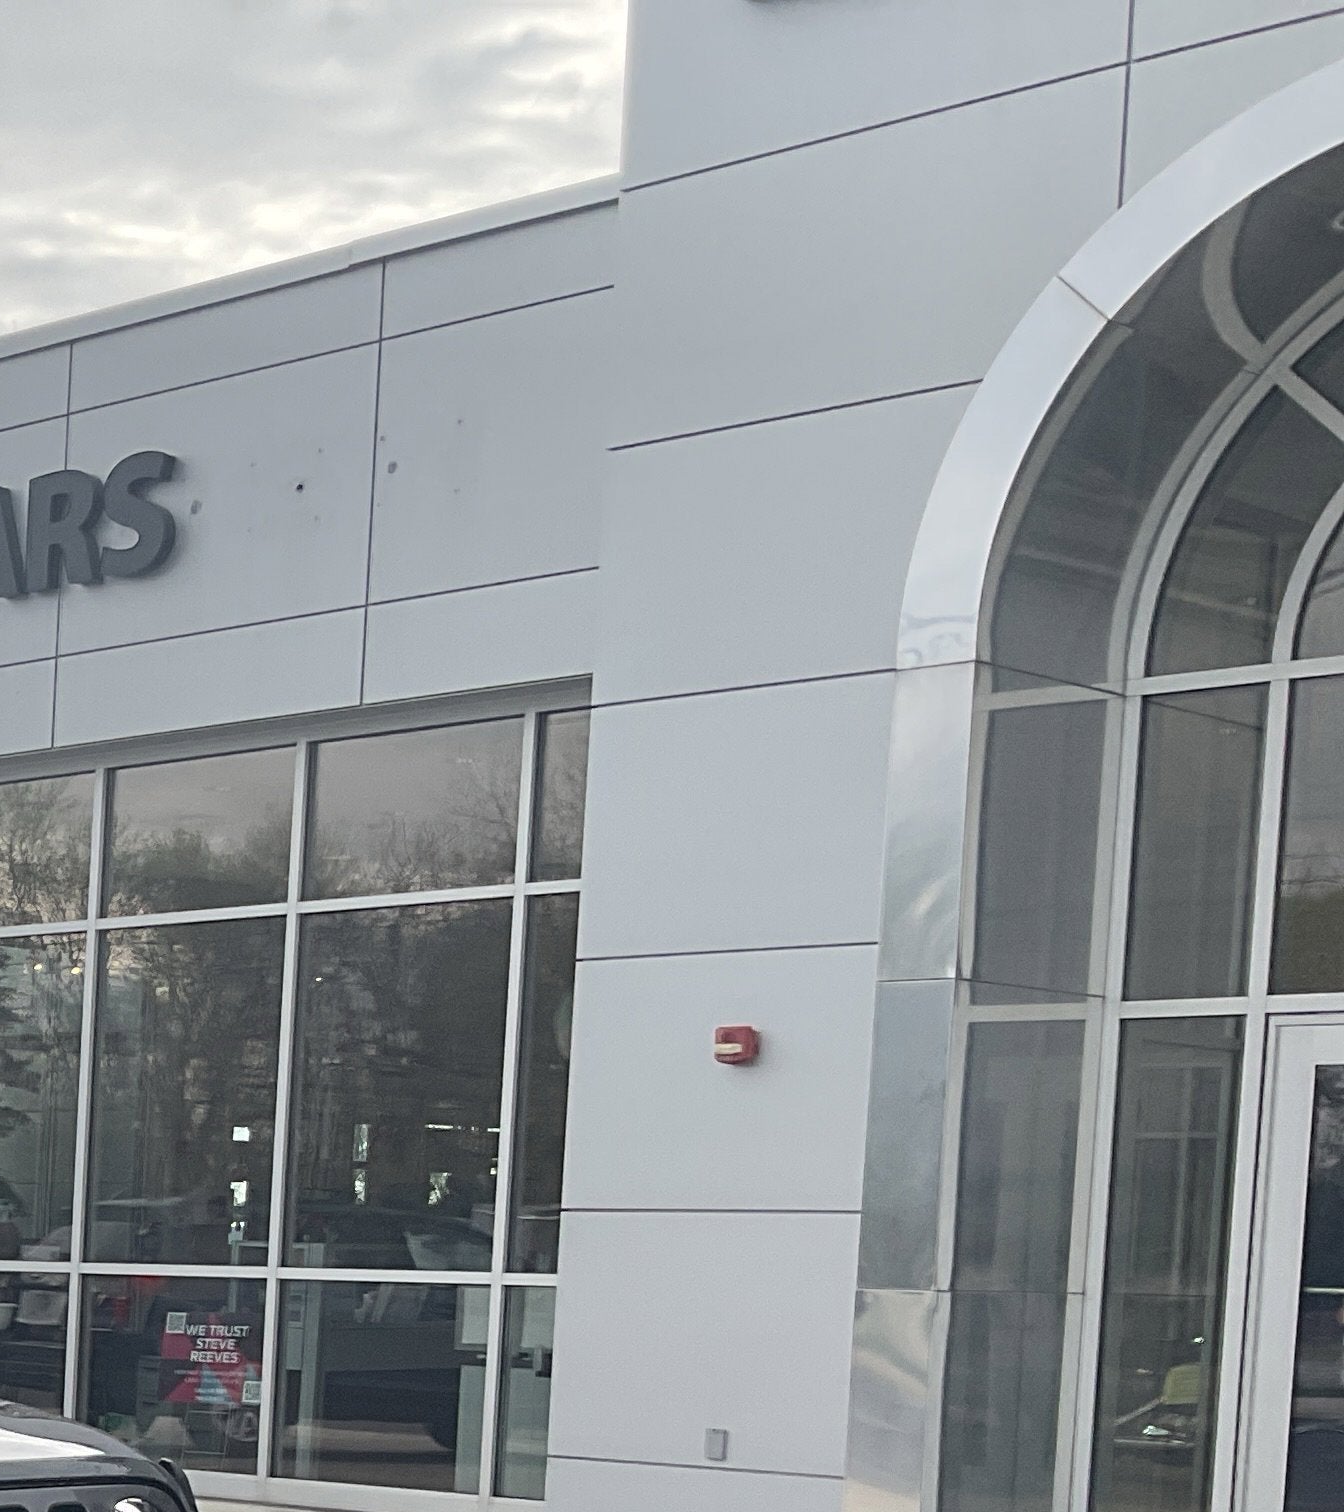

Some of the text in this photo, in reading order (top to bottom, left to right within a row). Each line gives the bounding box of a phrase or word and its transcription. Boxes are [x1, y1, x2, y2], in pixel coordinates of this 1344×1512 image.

[185, 1324, 249, 1337] WE TRUST
[195, 1338, 237, 1350] STEVE
[190, 1350, 240, 1363] REEVES
